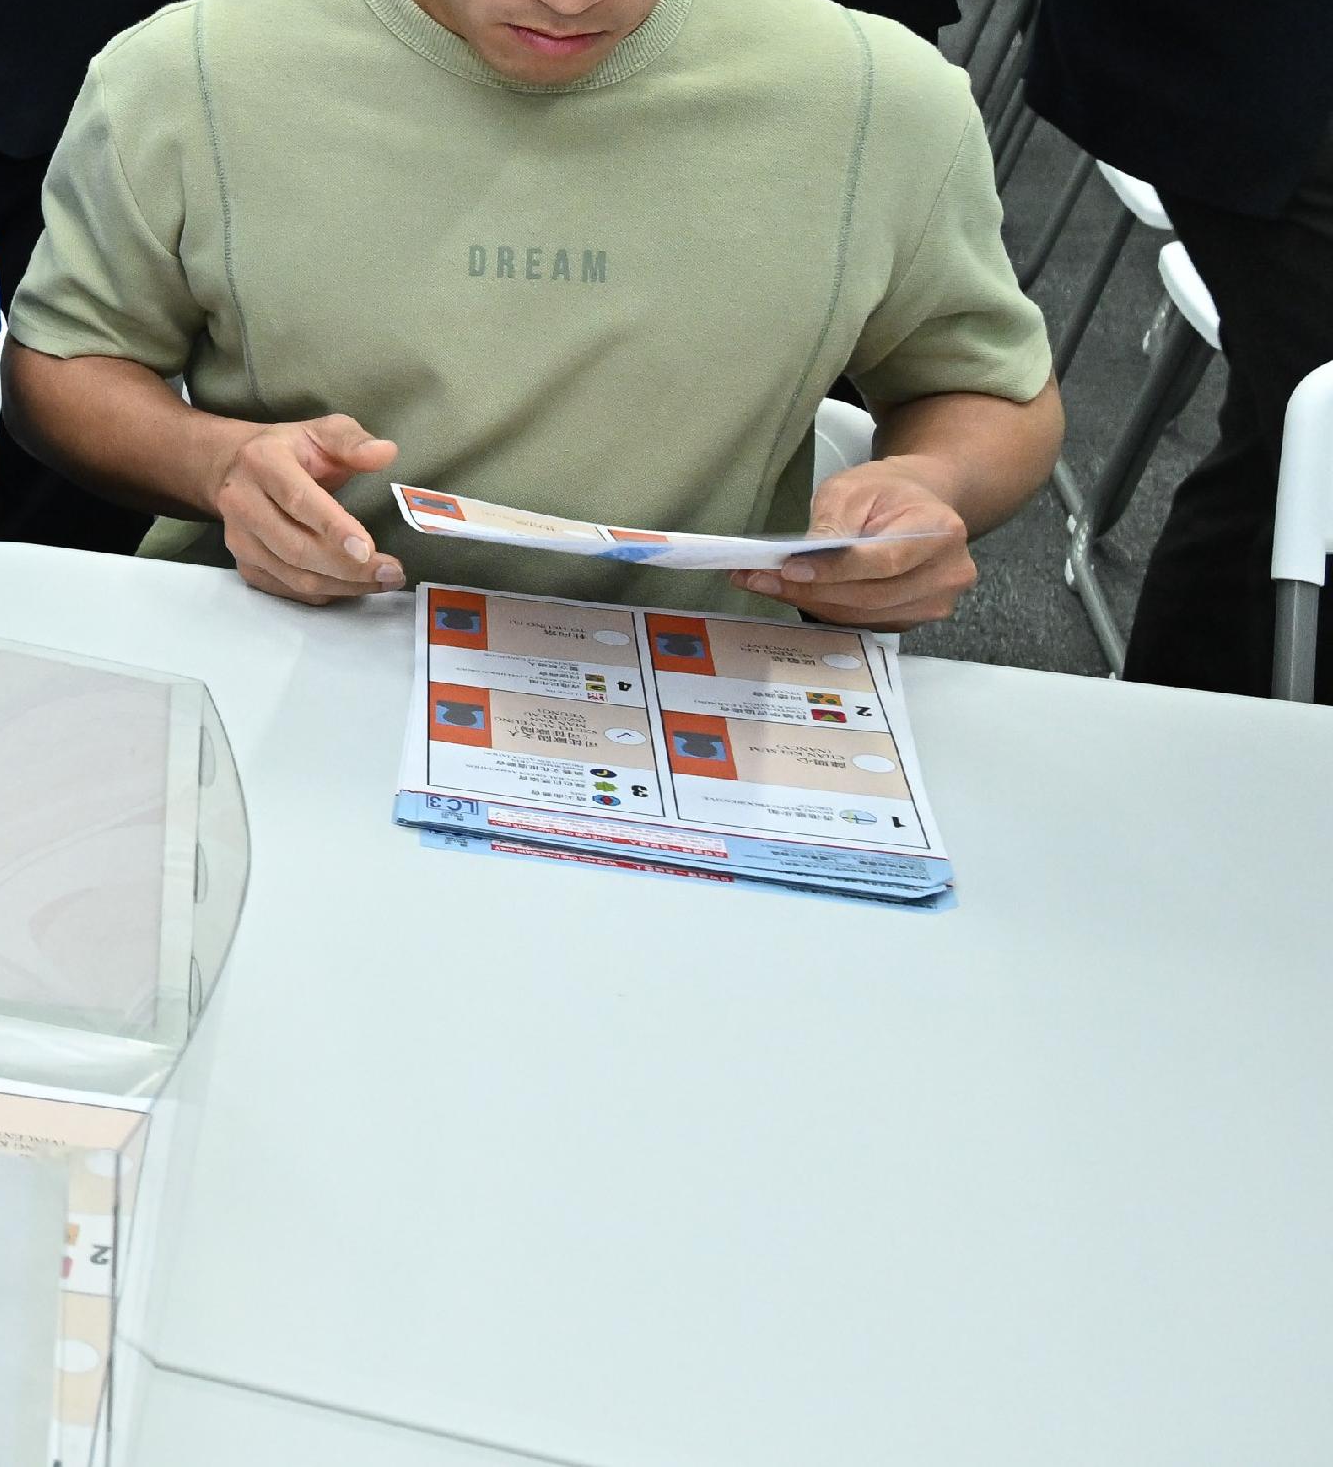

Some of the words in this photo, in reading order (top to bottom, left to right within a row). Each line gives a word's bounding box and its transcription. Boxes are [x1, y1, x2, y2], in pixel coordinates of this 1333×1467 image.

[468, 245, 607, 283] DREAM
[616, 680, 633, 692] 4
[853, 705, 873, 716] 2
[630, 784, 648, 797] 3
[428, 795, 441, 808] 3
[445, 797, 474, 812] LC
[889, 815, 906, 829] 1
[90, 1243, 110, 1267] 2
